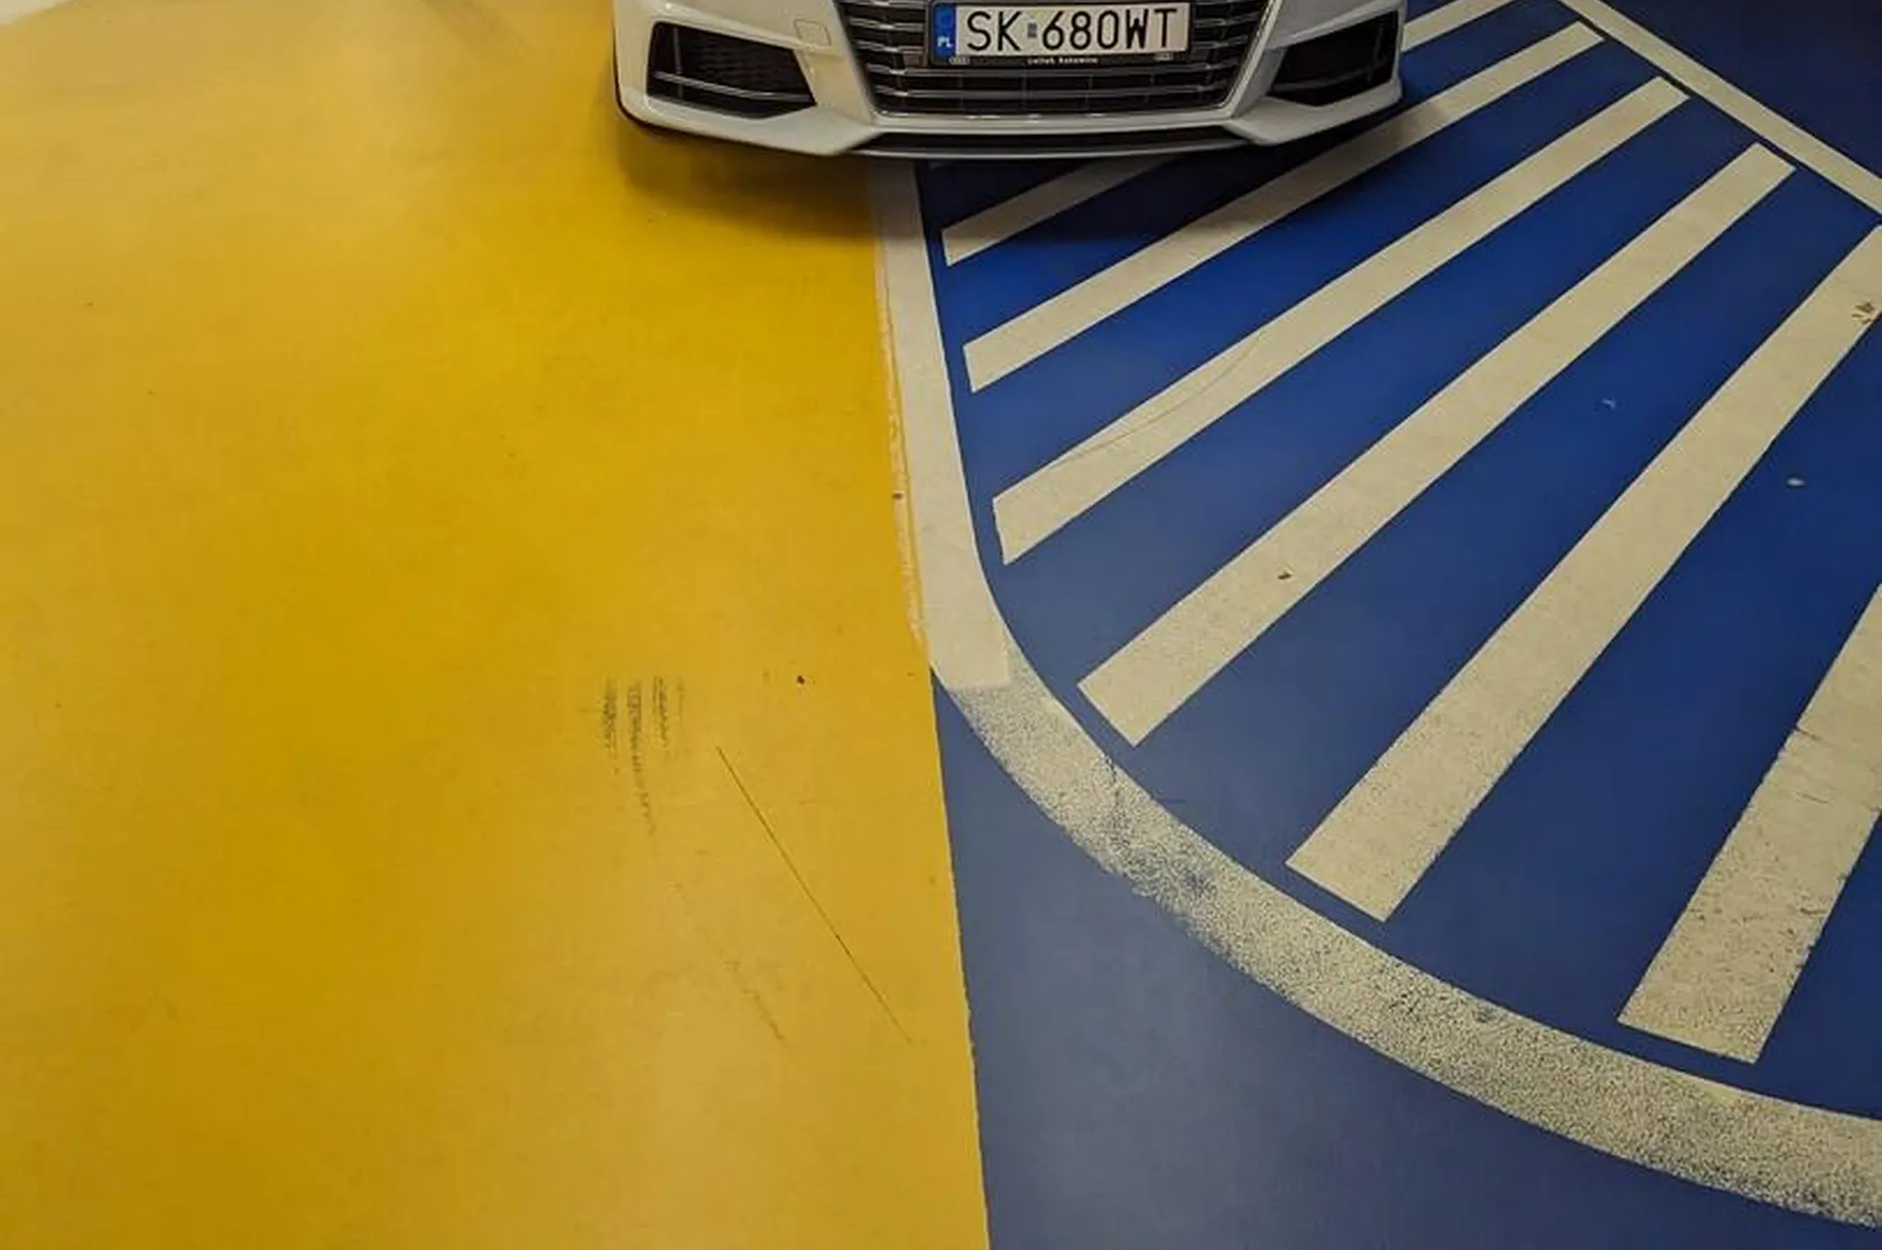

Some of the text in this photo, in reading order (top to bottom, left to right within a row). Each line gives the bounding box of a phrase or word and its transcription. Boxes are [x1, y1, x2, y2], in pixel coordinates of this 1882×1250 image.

[936, 35, 954, 48] PL
[966, 8, 1178, 52] SK 680WT
